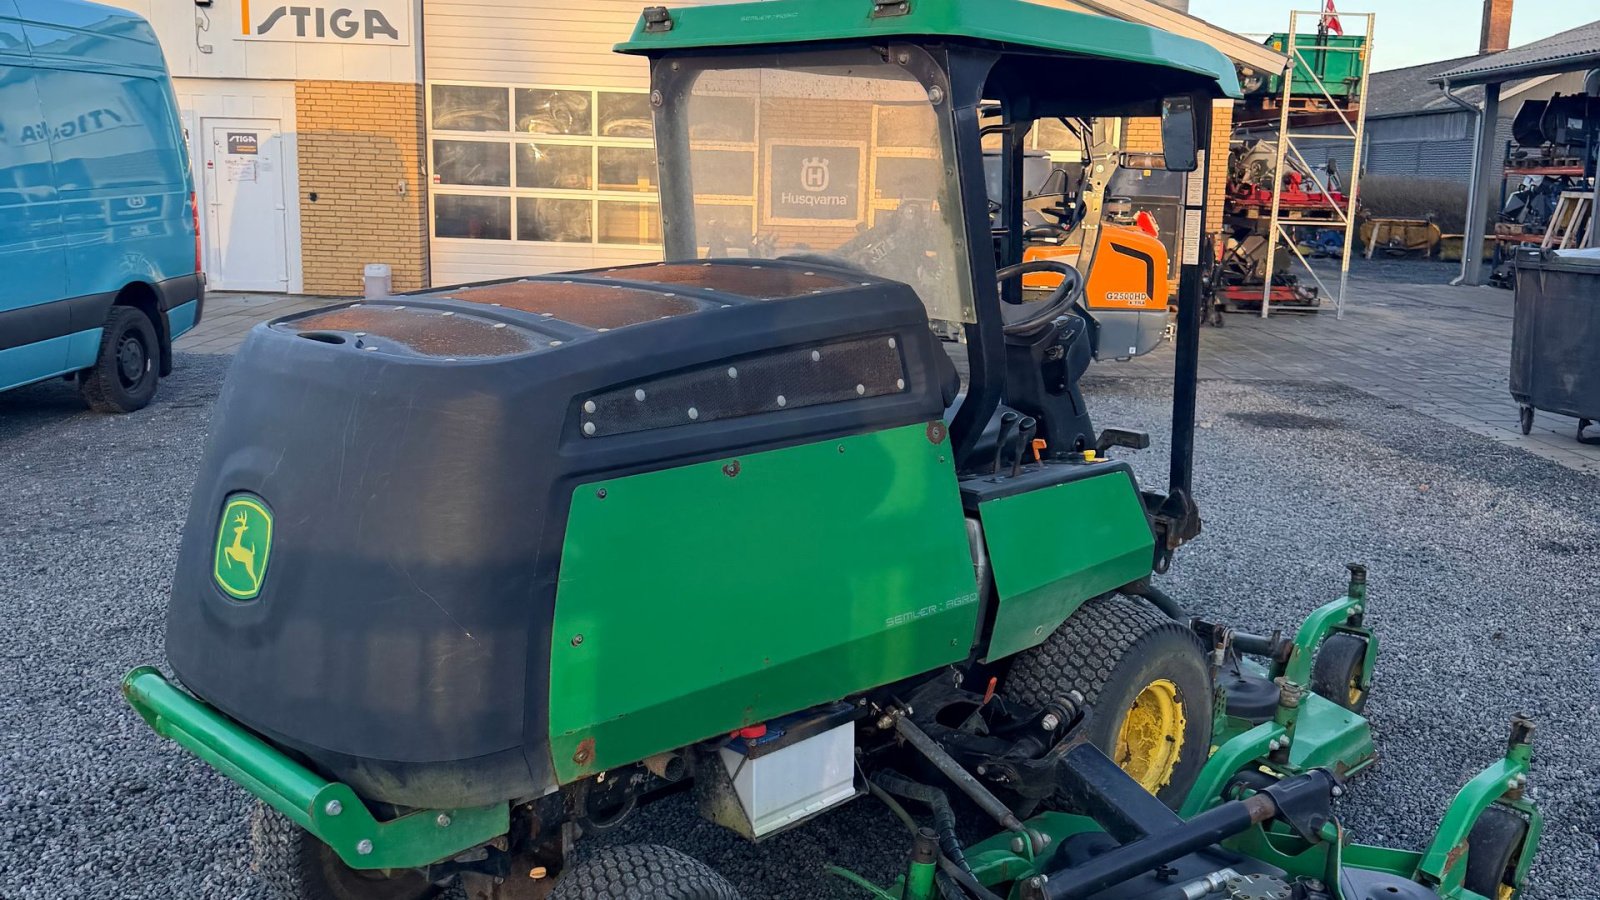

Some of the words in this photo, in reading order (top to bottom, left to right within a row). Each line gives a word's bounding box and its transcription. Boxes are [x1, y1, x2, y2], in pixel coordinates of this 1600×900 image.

[257, 6, 399, 40] STIGA
[228, 135, 257, 143] STIGA
[781, 192, 847, 207] Husqvarna
[1106, 292, 1147, 300] G2500HD
[886, 604, 937, 627] SEMLER
[945, 592, 978, 609] AGRO
